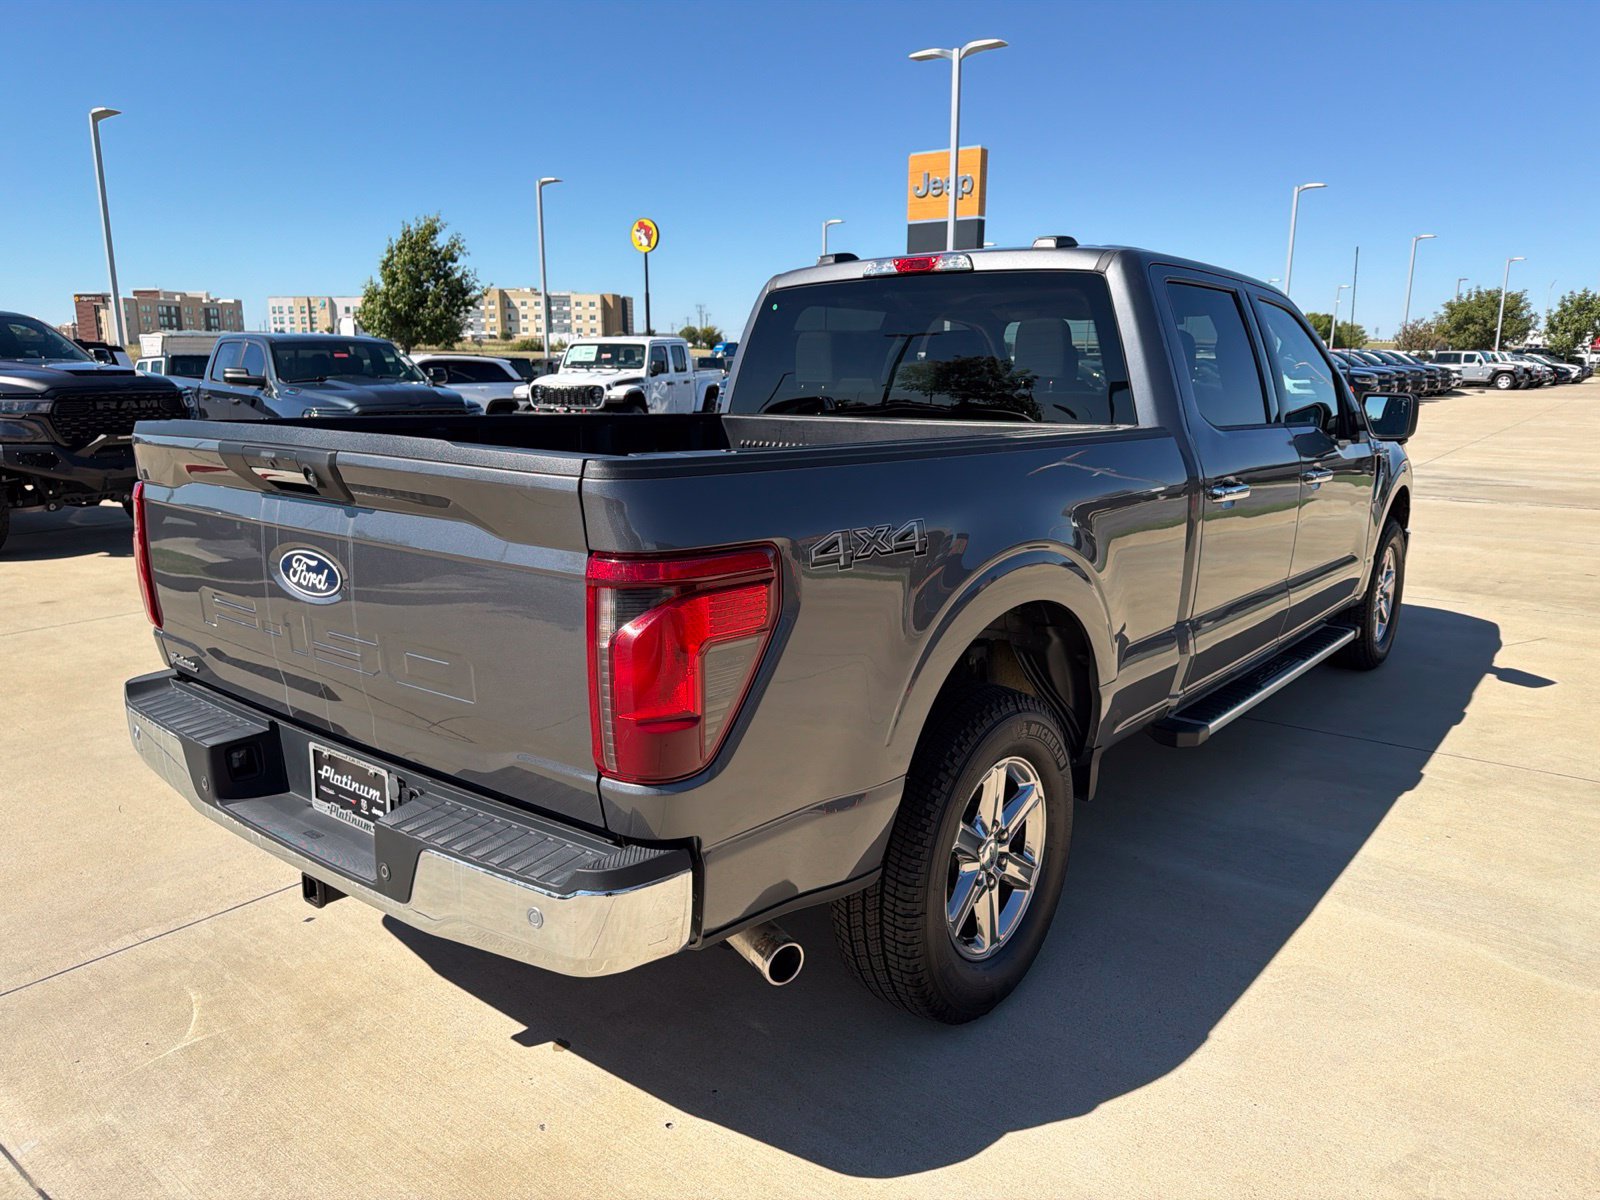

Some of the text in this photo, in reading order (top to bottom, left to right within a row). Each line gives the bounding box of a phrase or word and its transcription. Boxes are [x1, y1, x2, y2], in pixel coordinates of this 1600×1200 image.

[96, 399, 158, 410] RAM
[289, 555, 328, 591] Ford
[317, 764, 385, 804] Platinum
